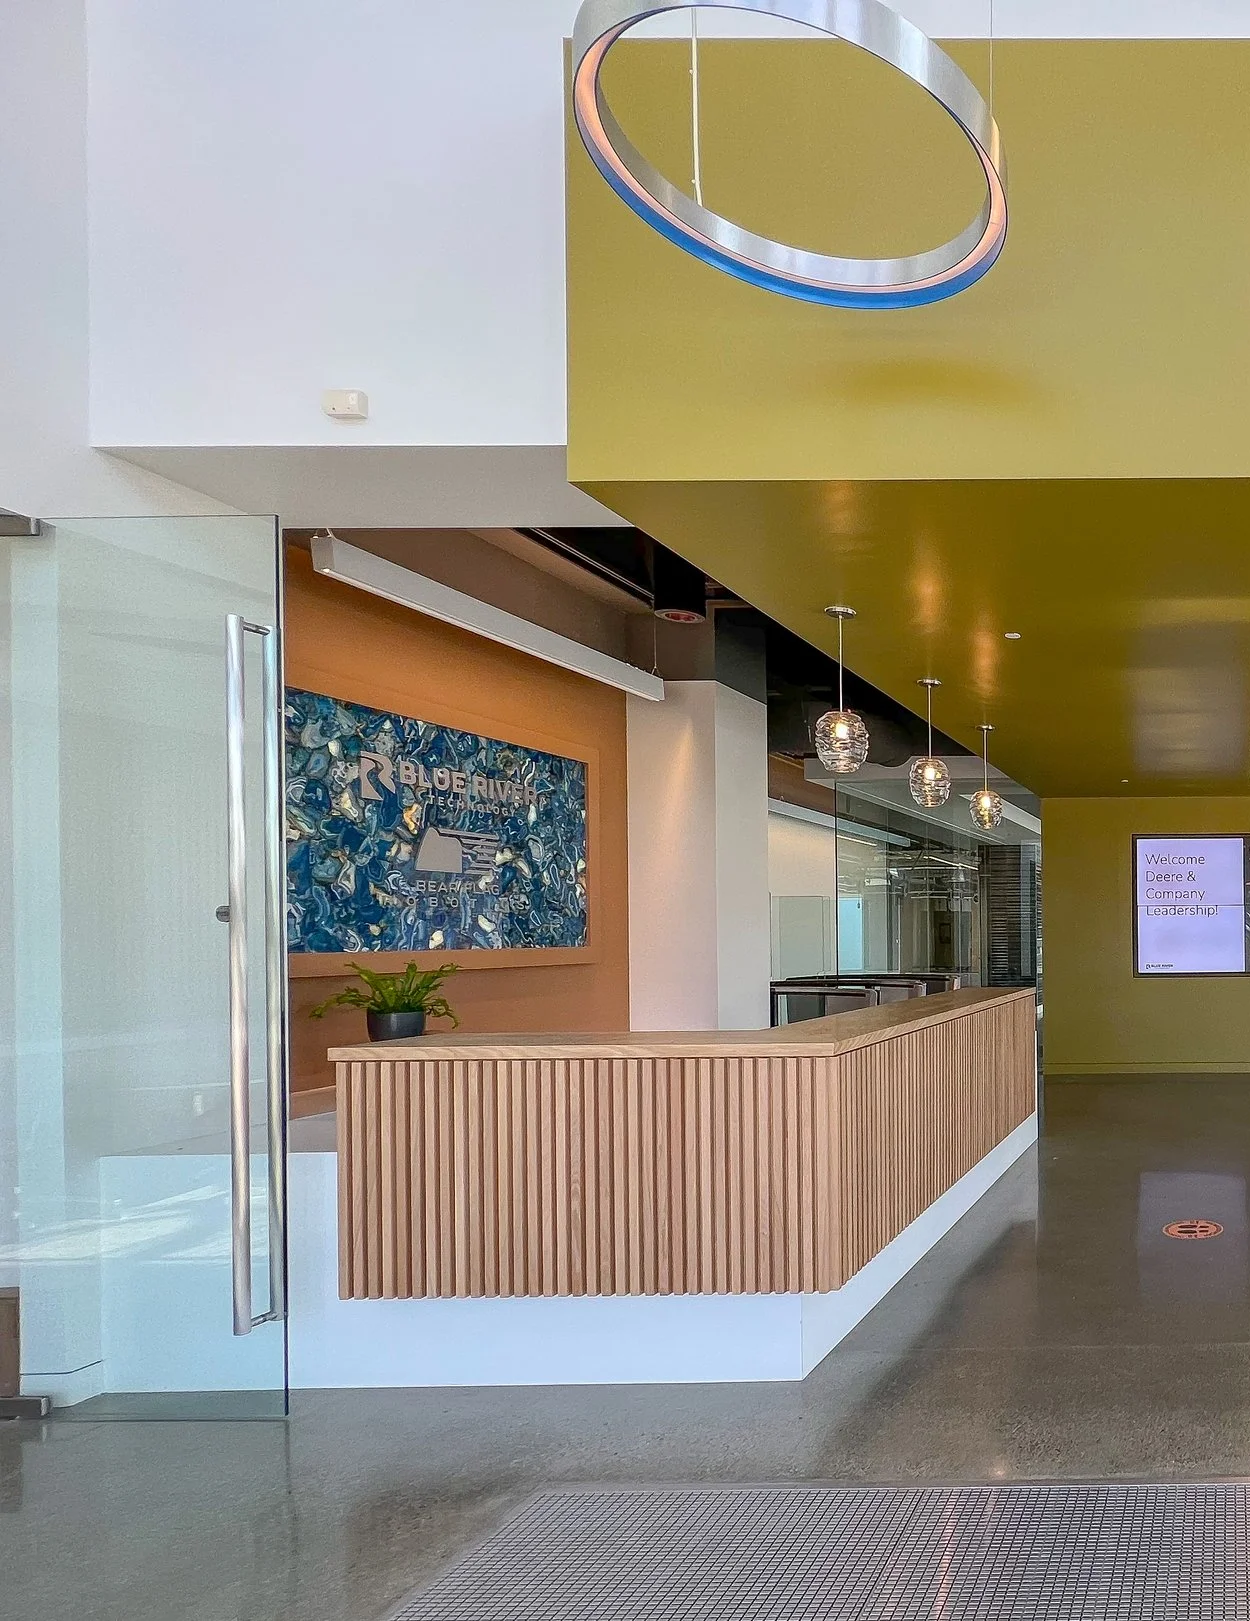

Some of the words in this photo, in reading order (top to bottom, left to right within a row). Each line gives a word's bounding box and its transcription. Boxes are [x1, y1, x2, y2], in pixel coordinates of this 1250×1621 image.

[400, 760, 467, 794] BLUE
[471, 775, 538, 806] RIVER
[1145, 853, 1205, 865] Welcome
[1146, 870, 1183, 882] Deere
[1187, 870, 1196, 882] &
[416, 880, 459, 894] BEAR
[467, 882, 500, 896] FLAG
[1145, 887, 1206, 902] Company
[1146, 904, 1218, 918] Leadership!
